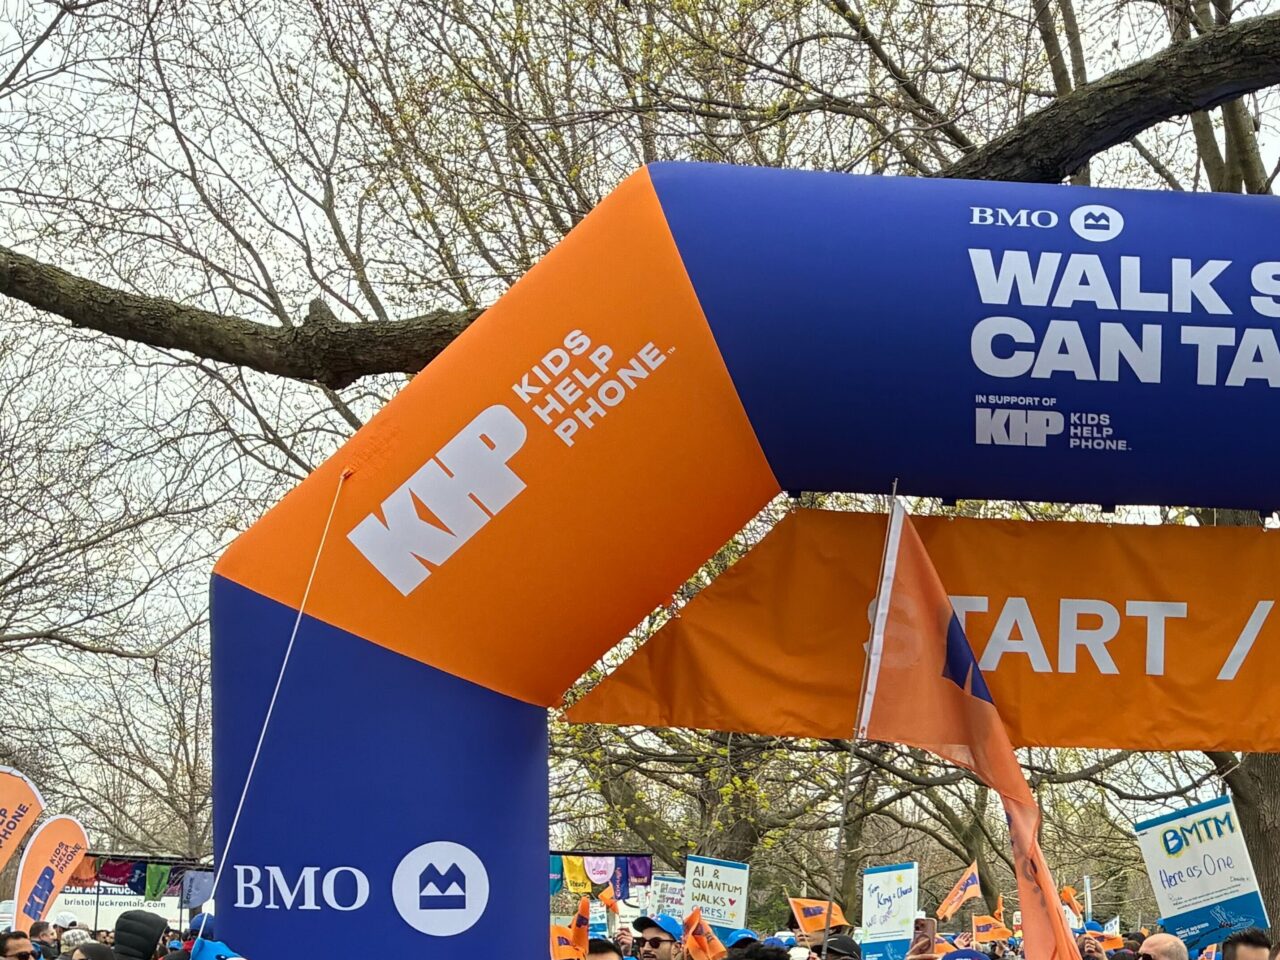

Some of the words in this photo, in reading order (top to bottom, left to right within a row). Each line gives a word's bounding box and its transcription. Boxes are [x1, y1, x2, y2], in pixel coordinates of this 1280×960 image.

[969, 206, 1059, 229] BMO
[968, 248, 1233, 315] WALK
[970, 316, 1162, 384] CAN
[511, 328, 592, 405] KIDS
[532, 344, 616, 426] HELP
[975, 395, 987, 403] IN
[989, 395, 1040, 406] SUPPORT
[1042, 397, 1057, 406] OF
[975, 408, 1065, 447] KHP
[1070, 412, 1111, 425] KIDS
[1070, 425, 1113, 438] HELP
[346, 404, 528, 597] KHP
[0, 803, 29, 848] HONE
[1163, 812, 1235, 856] BMTM
[50, 842, 65, 865] KIDS
[55, 845, 70, 869] HELP
[692, 878, 742, 896] QUANTUM
[693, 865, 705, 877] AI
[712, 868, 720, 880] &
[1159, 869, 1186, 890] Here
[1186, 865, 1203, 879] as
[1203, 854, 1235, 876] One
[23, 866, 55, 921] KHP
[64, 886, 83, 894] CAR
[85, 886, 104, 894] AND
[233, 865, 370, 911] BMO
[691, 892, 726, 907] WALKS
[64, 898, 166, 909] bristoltuckrentals.com
